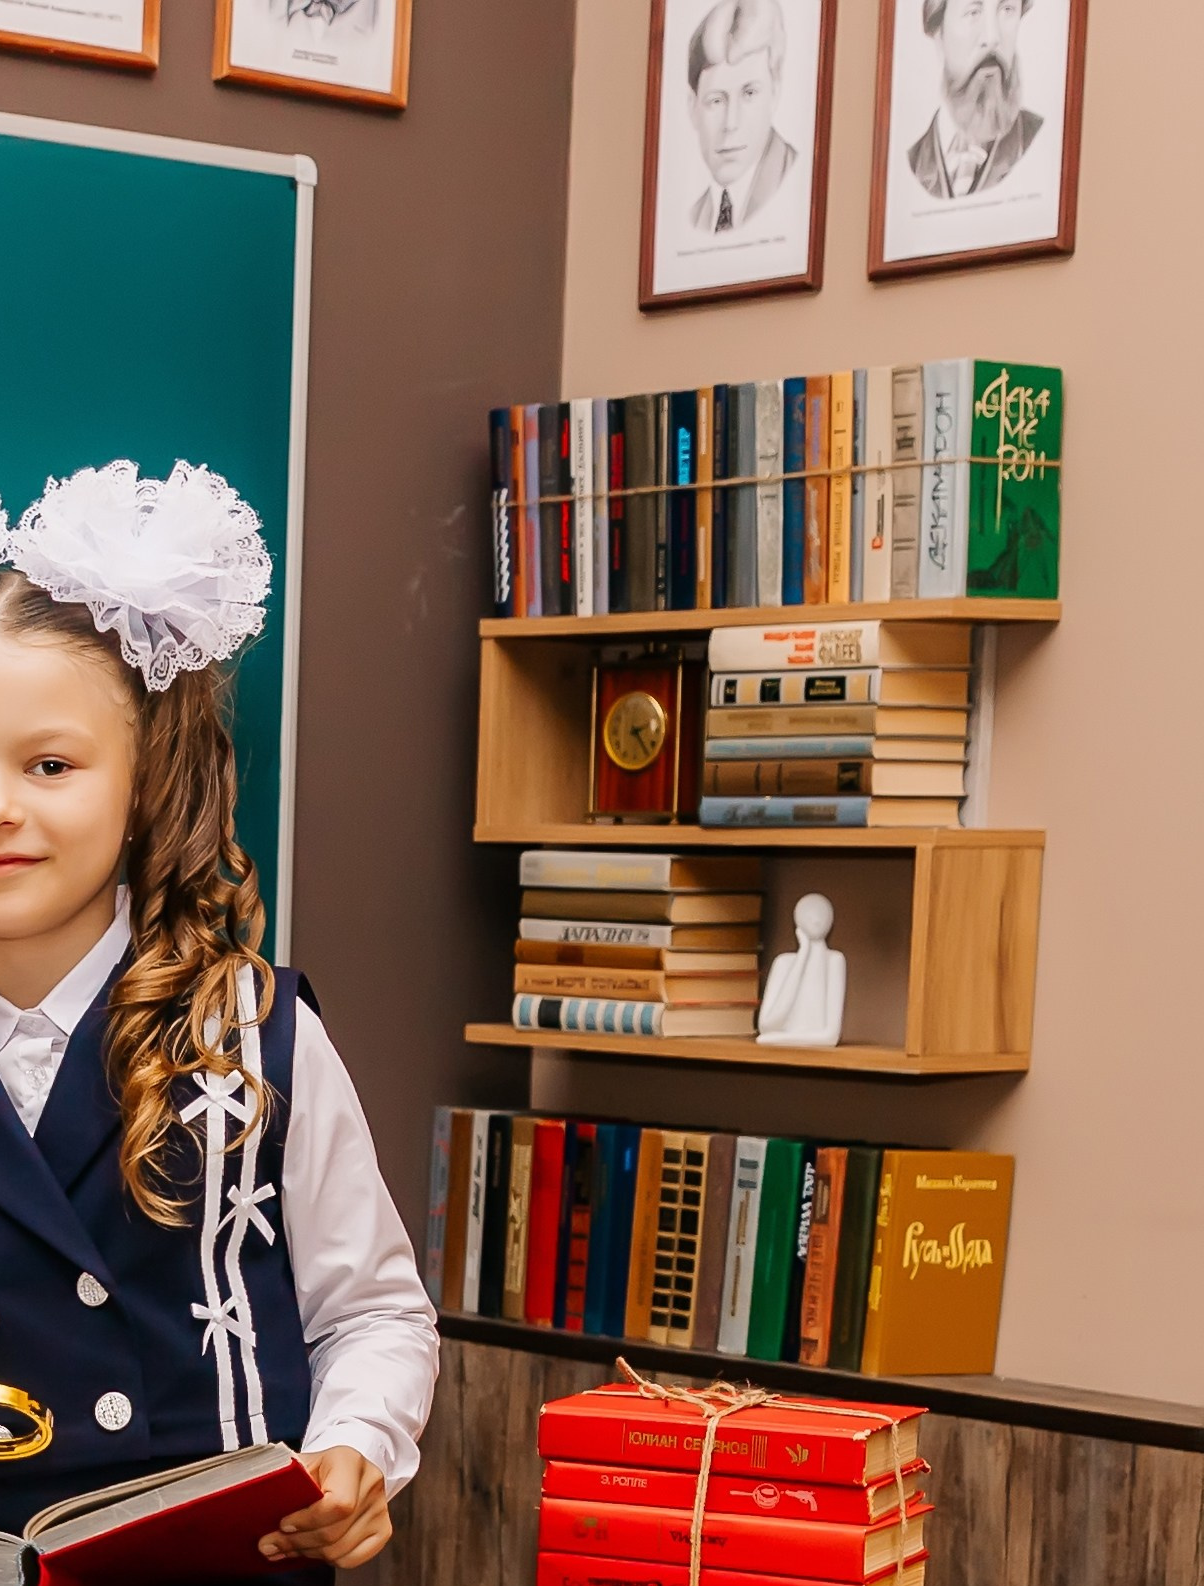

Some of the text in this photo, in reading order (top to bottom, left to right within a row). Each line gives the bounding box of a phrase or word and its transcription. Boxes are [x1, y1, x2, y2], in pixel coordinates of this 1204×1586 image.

[627, 1431, 750, 1457] ЮЛИАН СЕЕНОВ
[600, 1474, 611, 1486] Э.
